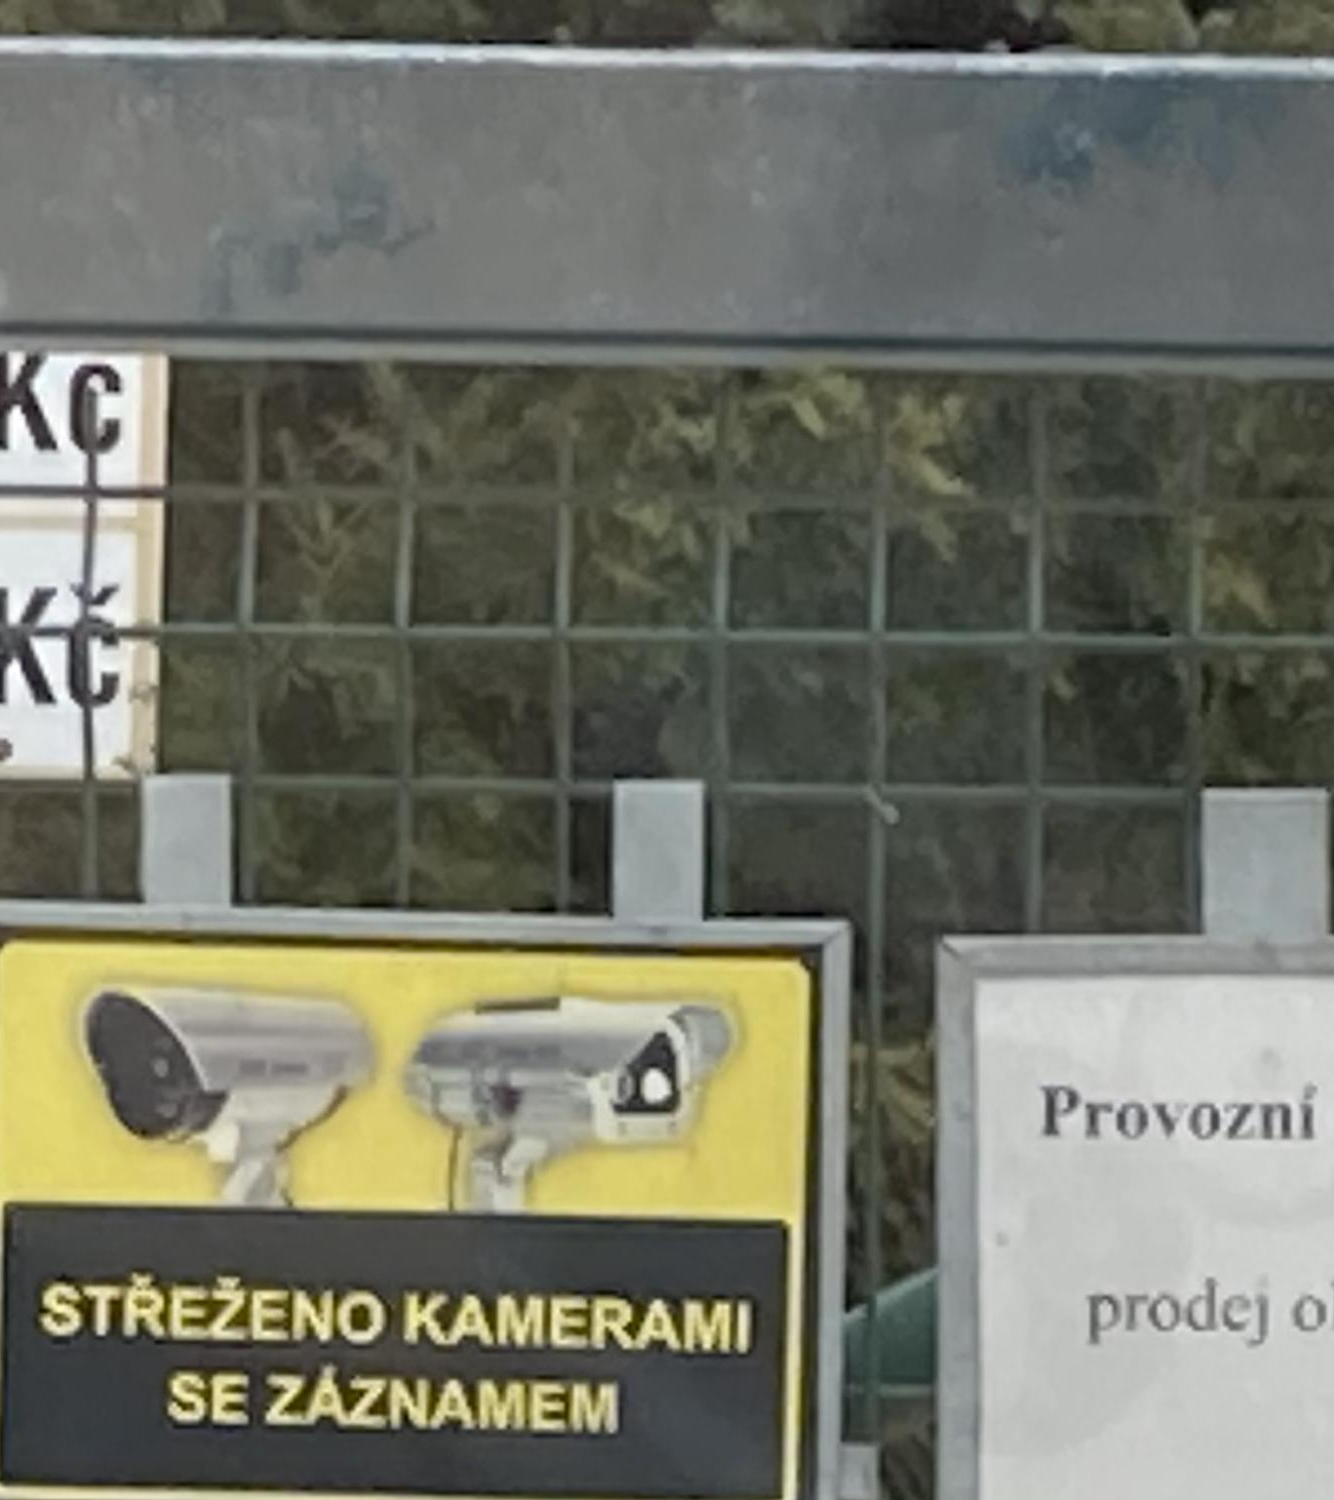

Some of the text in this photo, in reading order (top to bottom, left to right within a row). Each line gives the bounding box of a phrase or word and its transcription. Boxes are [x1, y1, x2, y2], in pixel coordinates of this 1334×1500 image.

[1040, 1082, 1318, 1141] Provozní
[39, 1271, 752, 1354] STŘEŽENO KAMERAMI
[1086, 1275, 1271, 1348] prodej
[166, 1364, 620, 1435] SE ZÁZNAMEM
